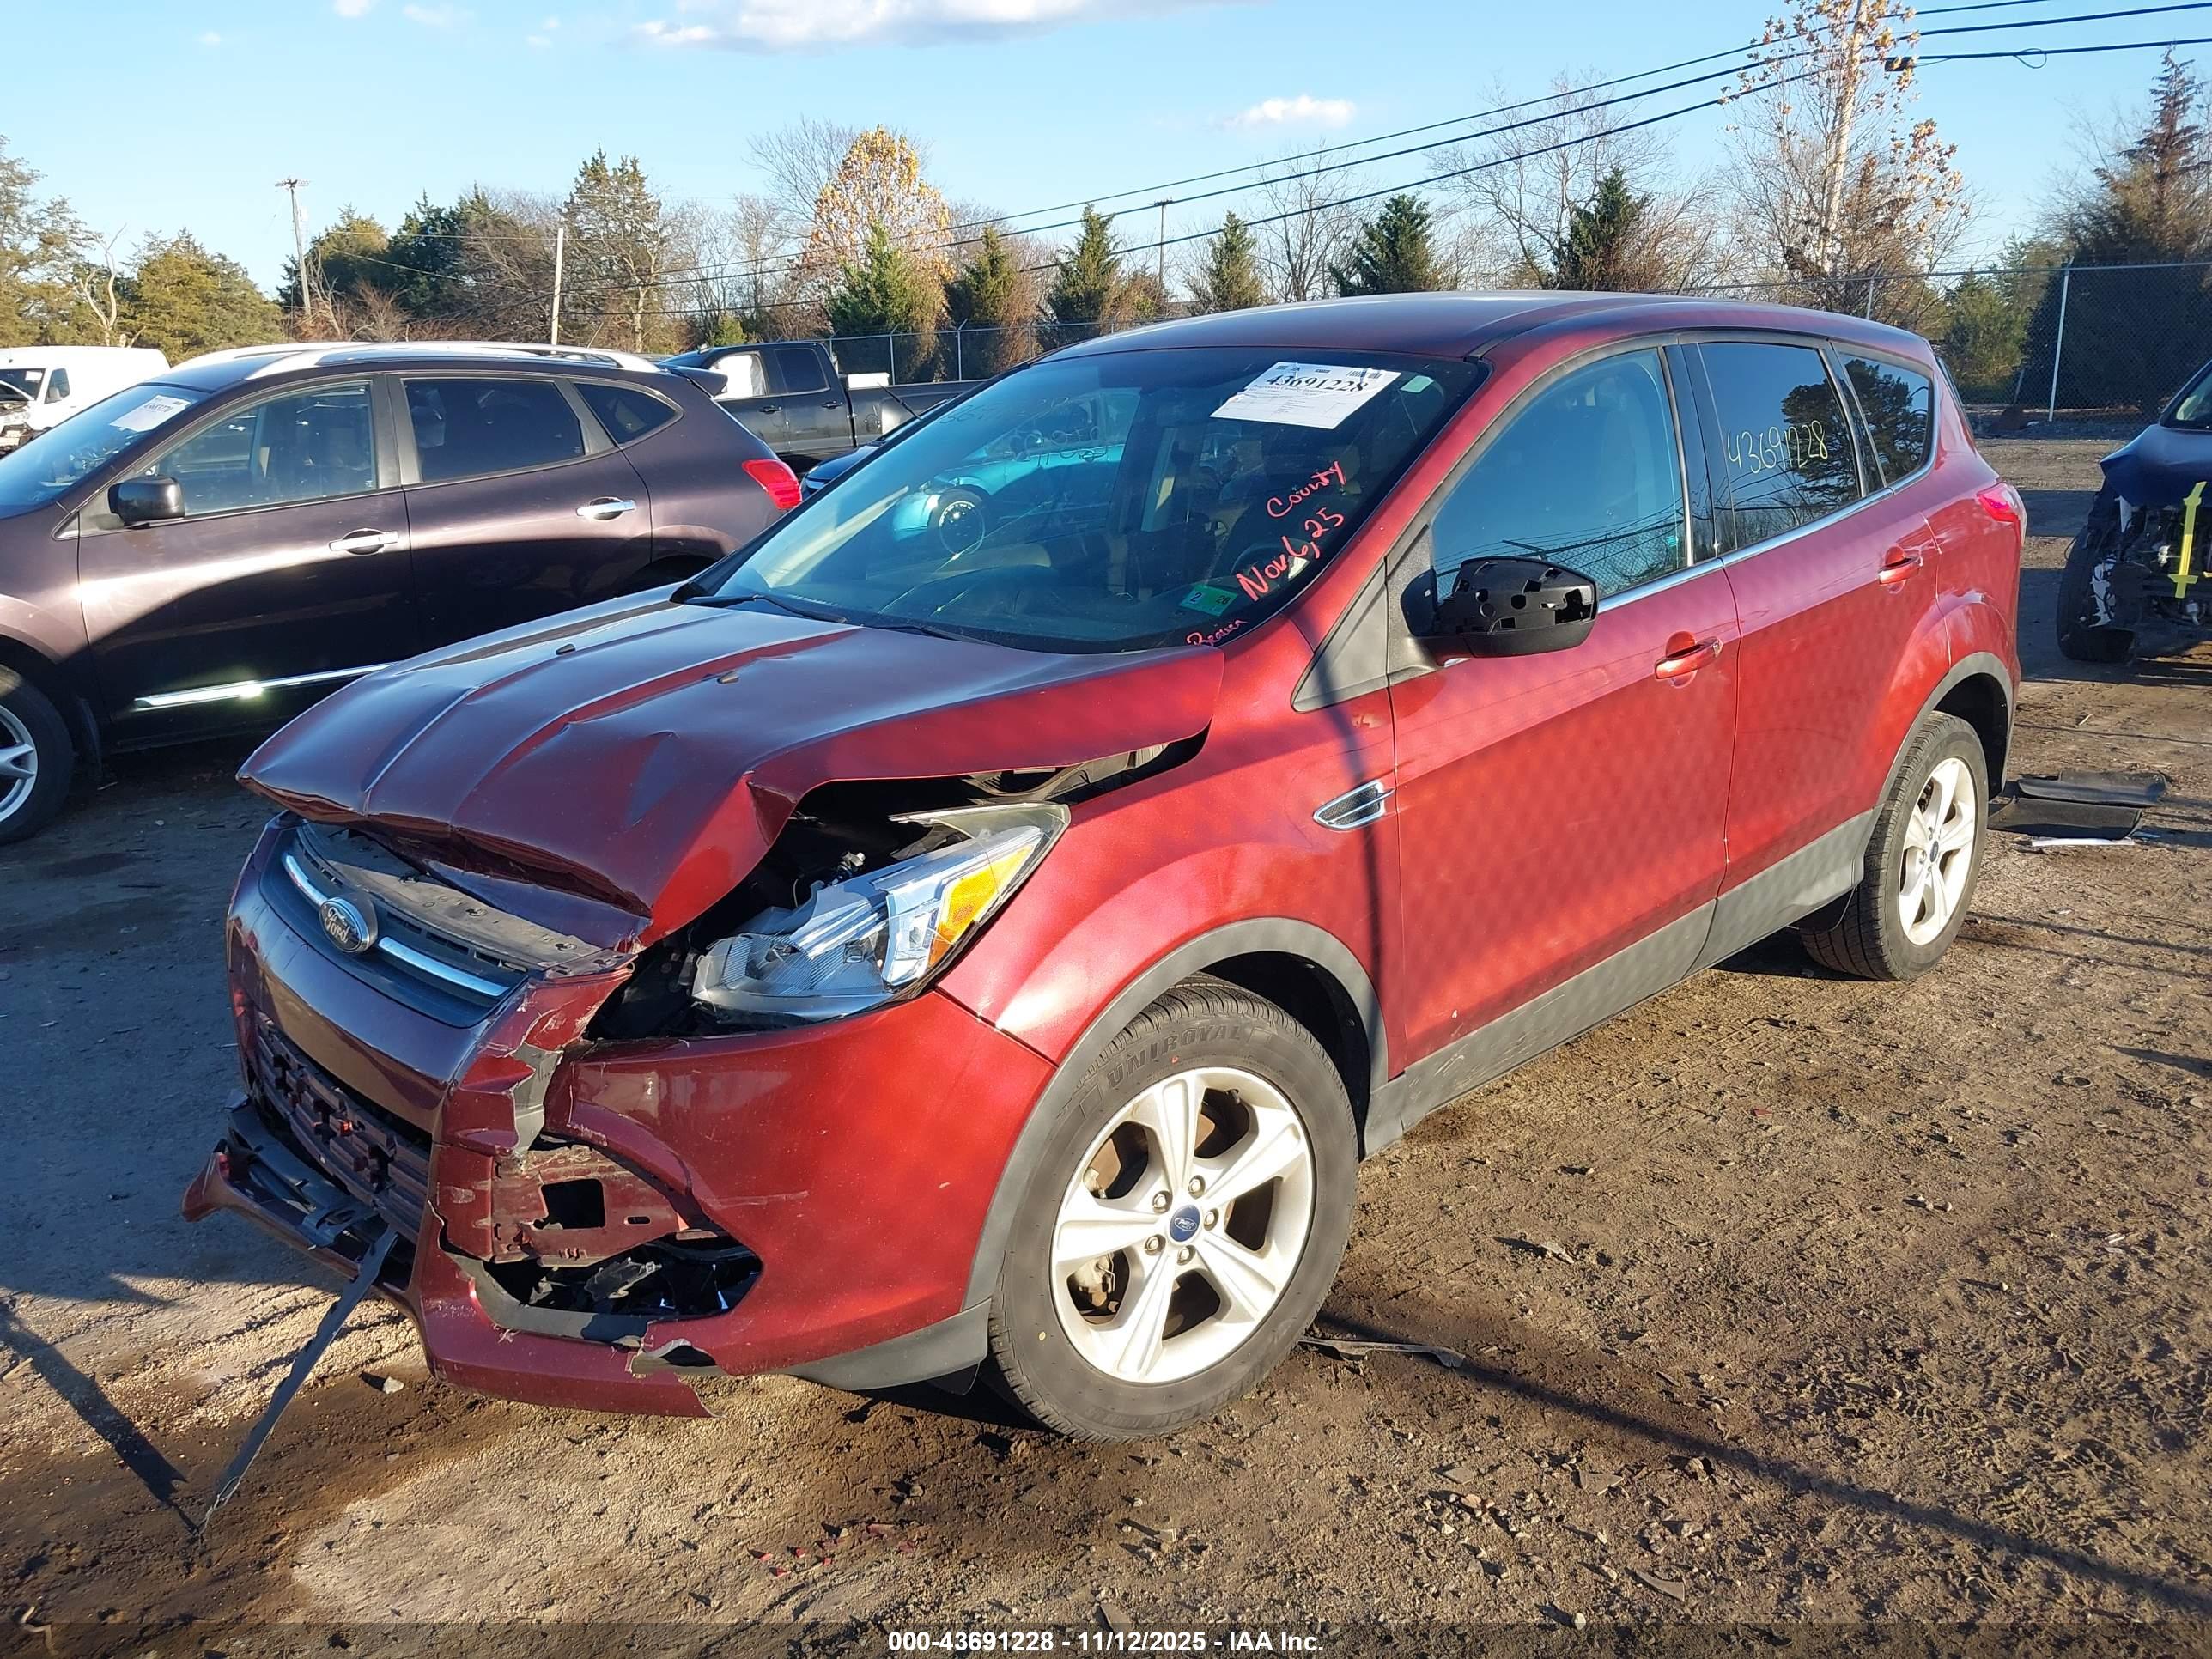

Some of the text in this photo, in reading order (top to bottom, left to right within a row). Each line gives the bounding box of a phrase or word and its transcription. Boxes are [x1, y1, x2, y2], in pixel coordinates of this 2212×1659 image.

[1266, 374, 1369, 392] 43691228
[1727, 420, 1828, 473] 43691228
[1267, 460, 1346, 518] County
[1190, 592, 1202, 603] 2
[324, 907, 350, 944] Ford
[1107, 1024, 1242, 1088] UNIROYAL
